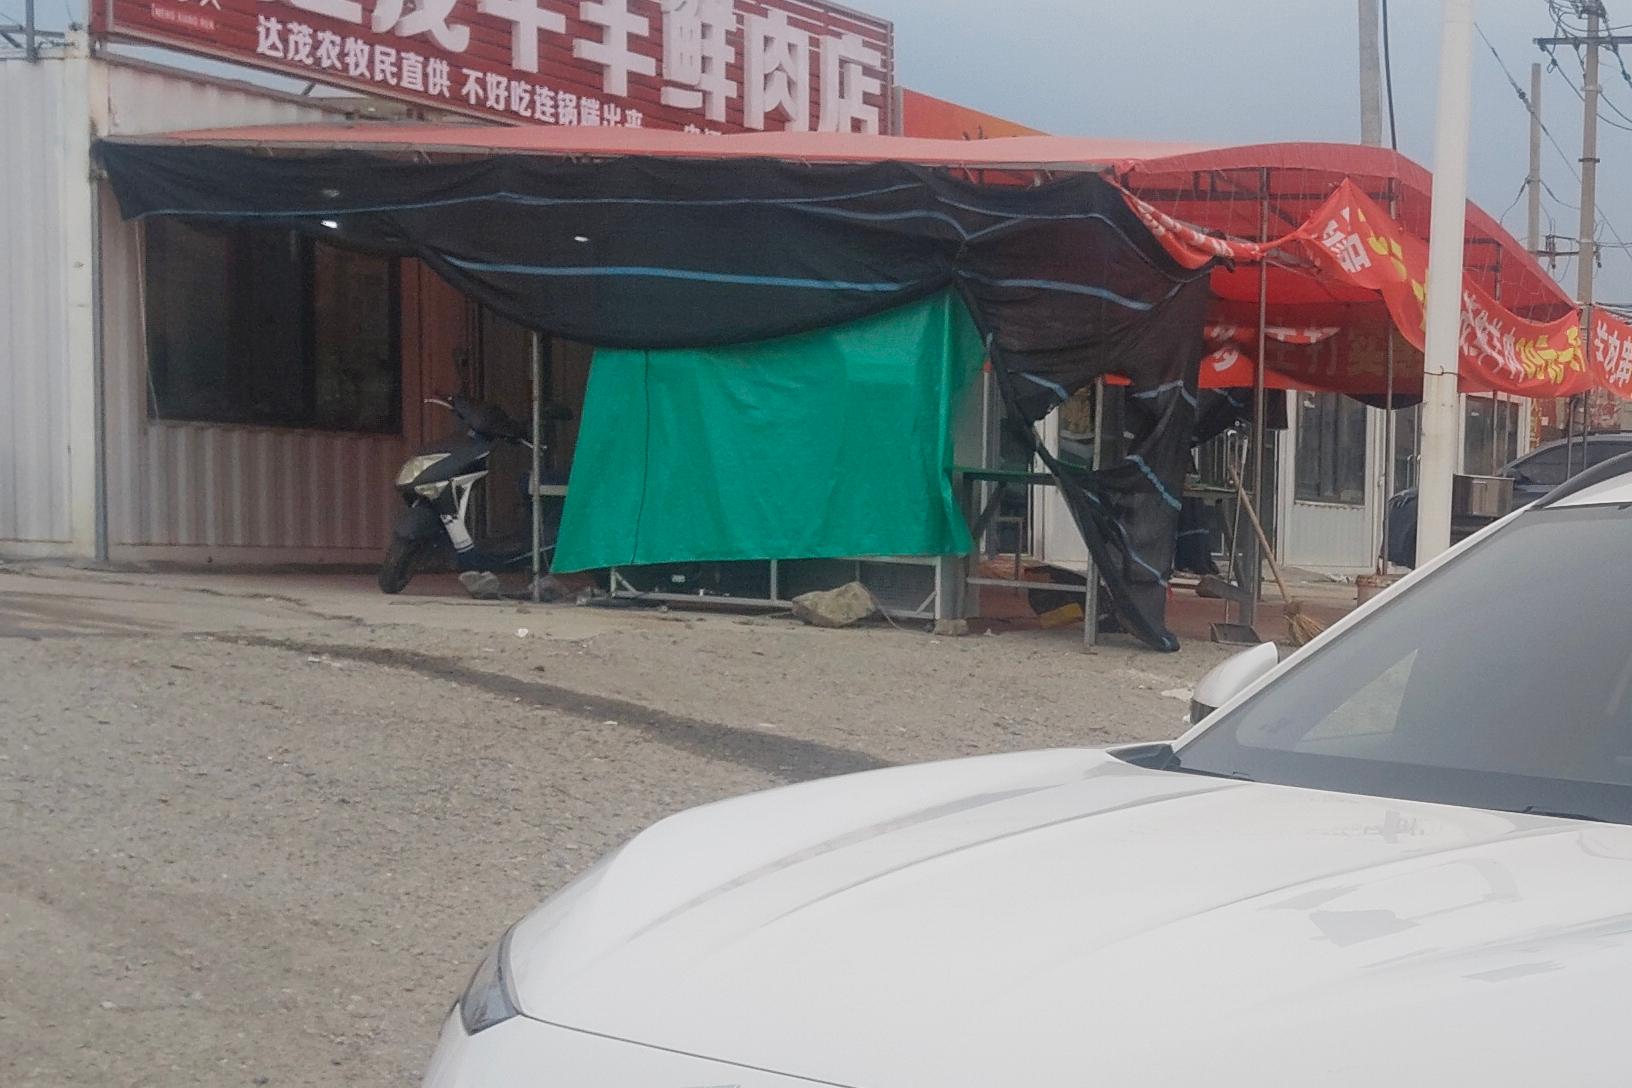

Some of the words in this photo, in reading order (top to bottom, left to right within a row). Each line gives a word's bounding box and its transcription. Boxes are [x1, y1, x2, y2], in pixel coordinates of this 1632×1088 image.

[256, 15, 450, 97] 达茂农牧民直供
